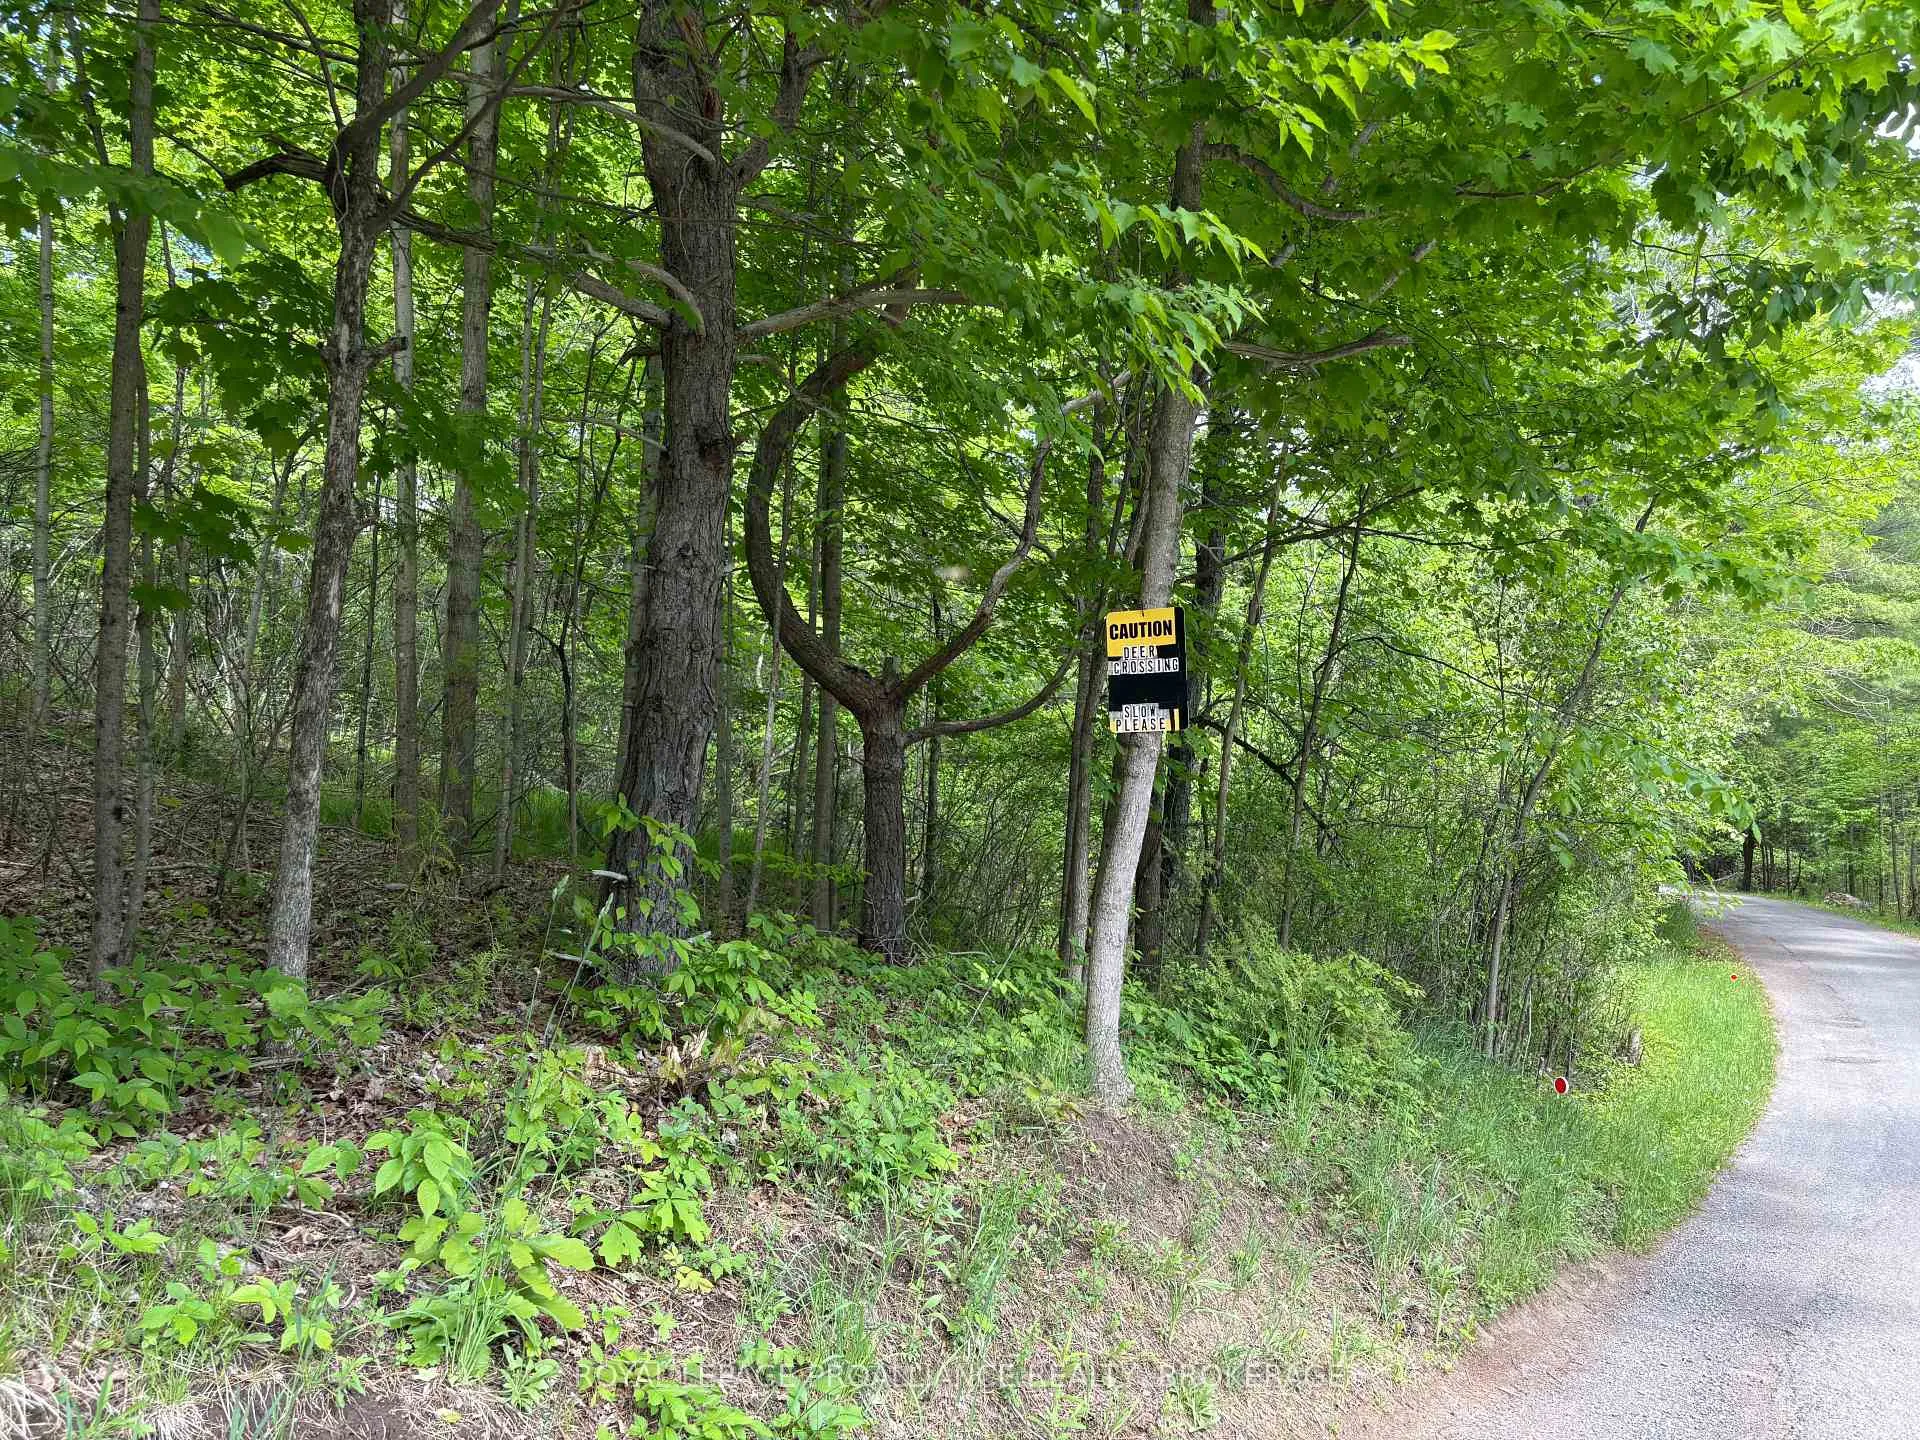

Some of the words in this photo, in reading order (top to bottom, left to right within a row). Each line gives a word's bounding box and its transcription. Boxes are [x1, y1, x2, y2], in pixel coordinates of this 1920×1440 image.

[1109, 619, 1172, 640] CAUTION
[1124, 646, 1156, 659] DEER
[1114, 658, 1178, 674] CROSSING
[1124, 706, 1156, 719] SLOW
[1116, 717, 1166, 731] PLEASE
